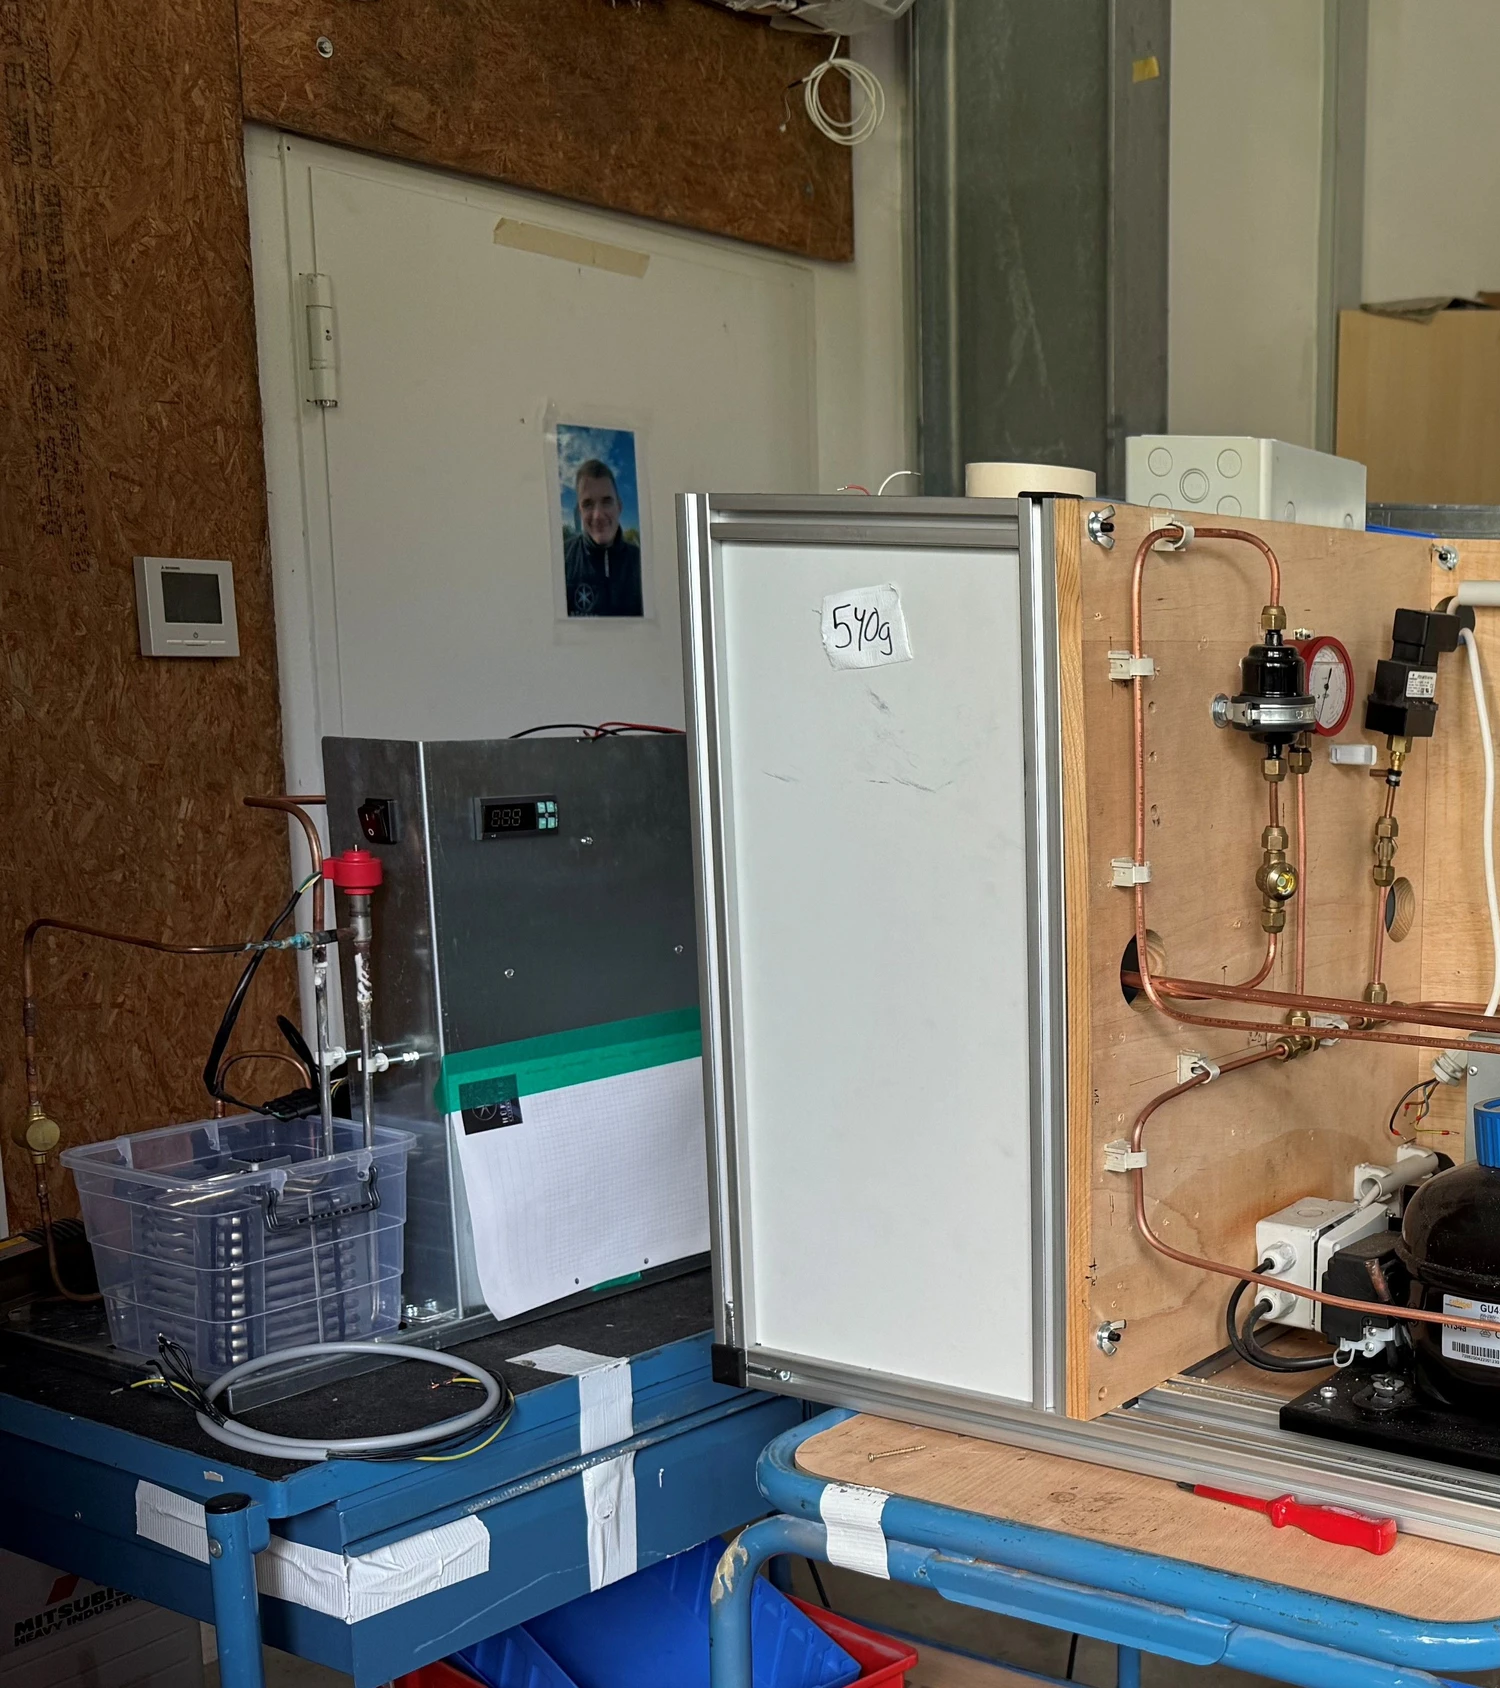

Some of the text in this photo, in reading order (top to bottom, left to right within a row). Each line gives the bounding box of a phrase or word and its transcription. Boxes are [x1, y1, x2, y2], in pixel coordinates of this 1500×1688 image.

[832, 603, 893, 656] 540g
[14, 1587, 126, 1638] MITSUBI
[14, 1620, 63, 1647] HEAVY
